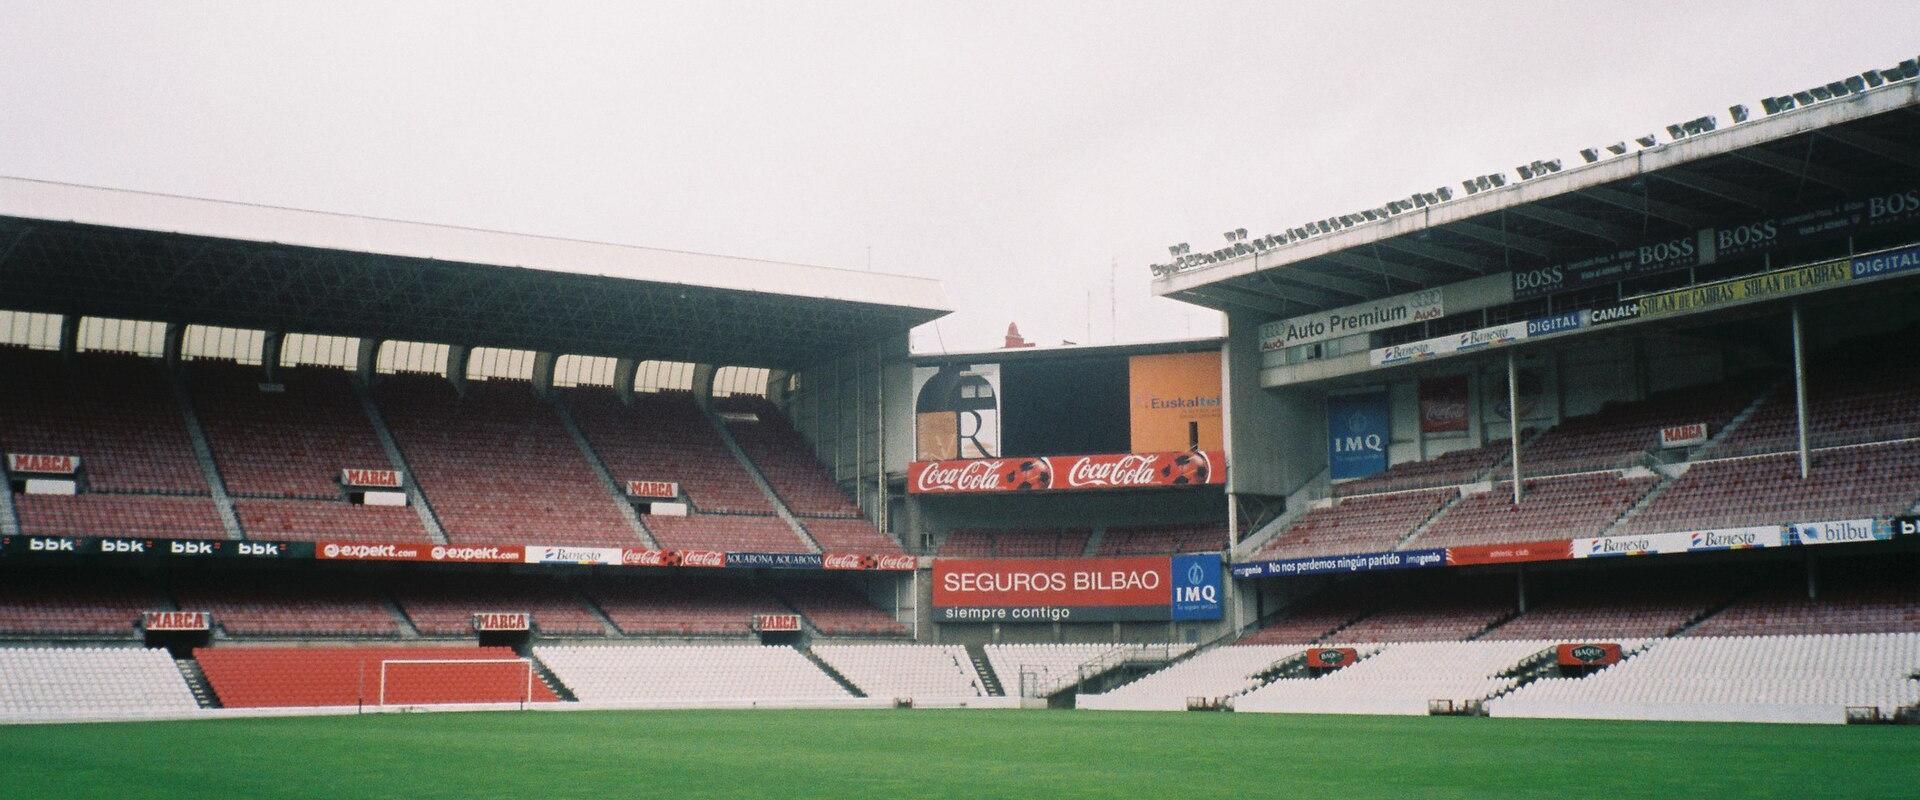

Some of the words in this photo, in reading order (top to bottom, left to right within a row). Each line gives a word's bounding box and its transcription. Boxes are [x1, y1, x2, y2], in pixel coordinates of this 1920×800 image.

[1718, 219, 1777, 249] BOSS
[1640, 237, 1694, 266] BOSS
[1856, 254, 1920, 274] DIGITAL
[1515, 265, 1563, 290] BOSS
[1286, 323, 1325, 341] Auto
[1330, 303, 1407, 332] Premium
[1414, 308, 1441, 320] Audi
[1591, 304, 1638, 323] CANAL+
[1529, 316, 1577, 333] DIGITAL
[1263, 339, 1285, 350] Audi
[1664, 425, 1703, 443] MARCA
[1335, 434, 1382, 452] IMQ
[15, 454, 72, 472] MARCA
[1068, 455, 1159, 486] Coca-Cola
[347, 470, 398, 487] MARCA
[918, 460, 1003, 491] Coca-Cola
[630, 481, 674, 497] MARCA
[30, 538, 74, 551] bbk
[102, 540, 144, 552] bbk
[1603, 538, 1649, 551] Banesto
[1704, 531, 1756, 546] Banesto
[171, 541, 212, 554] bbk
[238, 543, 278, 555] bbk
[557, 549, 601, 561] Banesto
[727, 553, 773, 565] AQUABONA
[776, 553, 822, 565] AQUABONA
[1269, 562, 1280, 573] No
[1282, 564, 1295, 572] nos
[1297, 559, 1336, 574] perdemos
[1337, 555, 1367, 571] ningún
[1369, 554, 1400, 568] partido
[944, 572, 1066, 592] SEGUROS
[1074, 571, 1159, 591] BILBAO
[1176, 585, 1216, 602] IMQ
[146, 613, 204, 629] MARCA
[478, 613, 526, 629] MARCA
[946, 607, 1006, 620] siempre
[1012, 606, 1070, 620] contigo
[757, 614, 798, 630] MARCA
